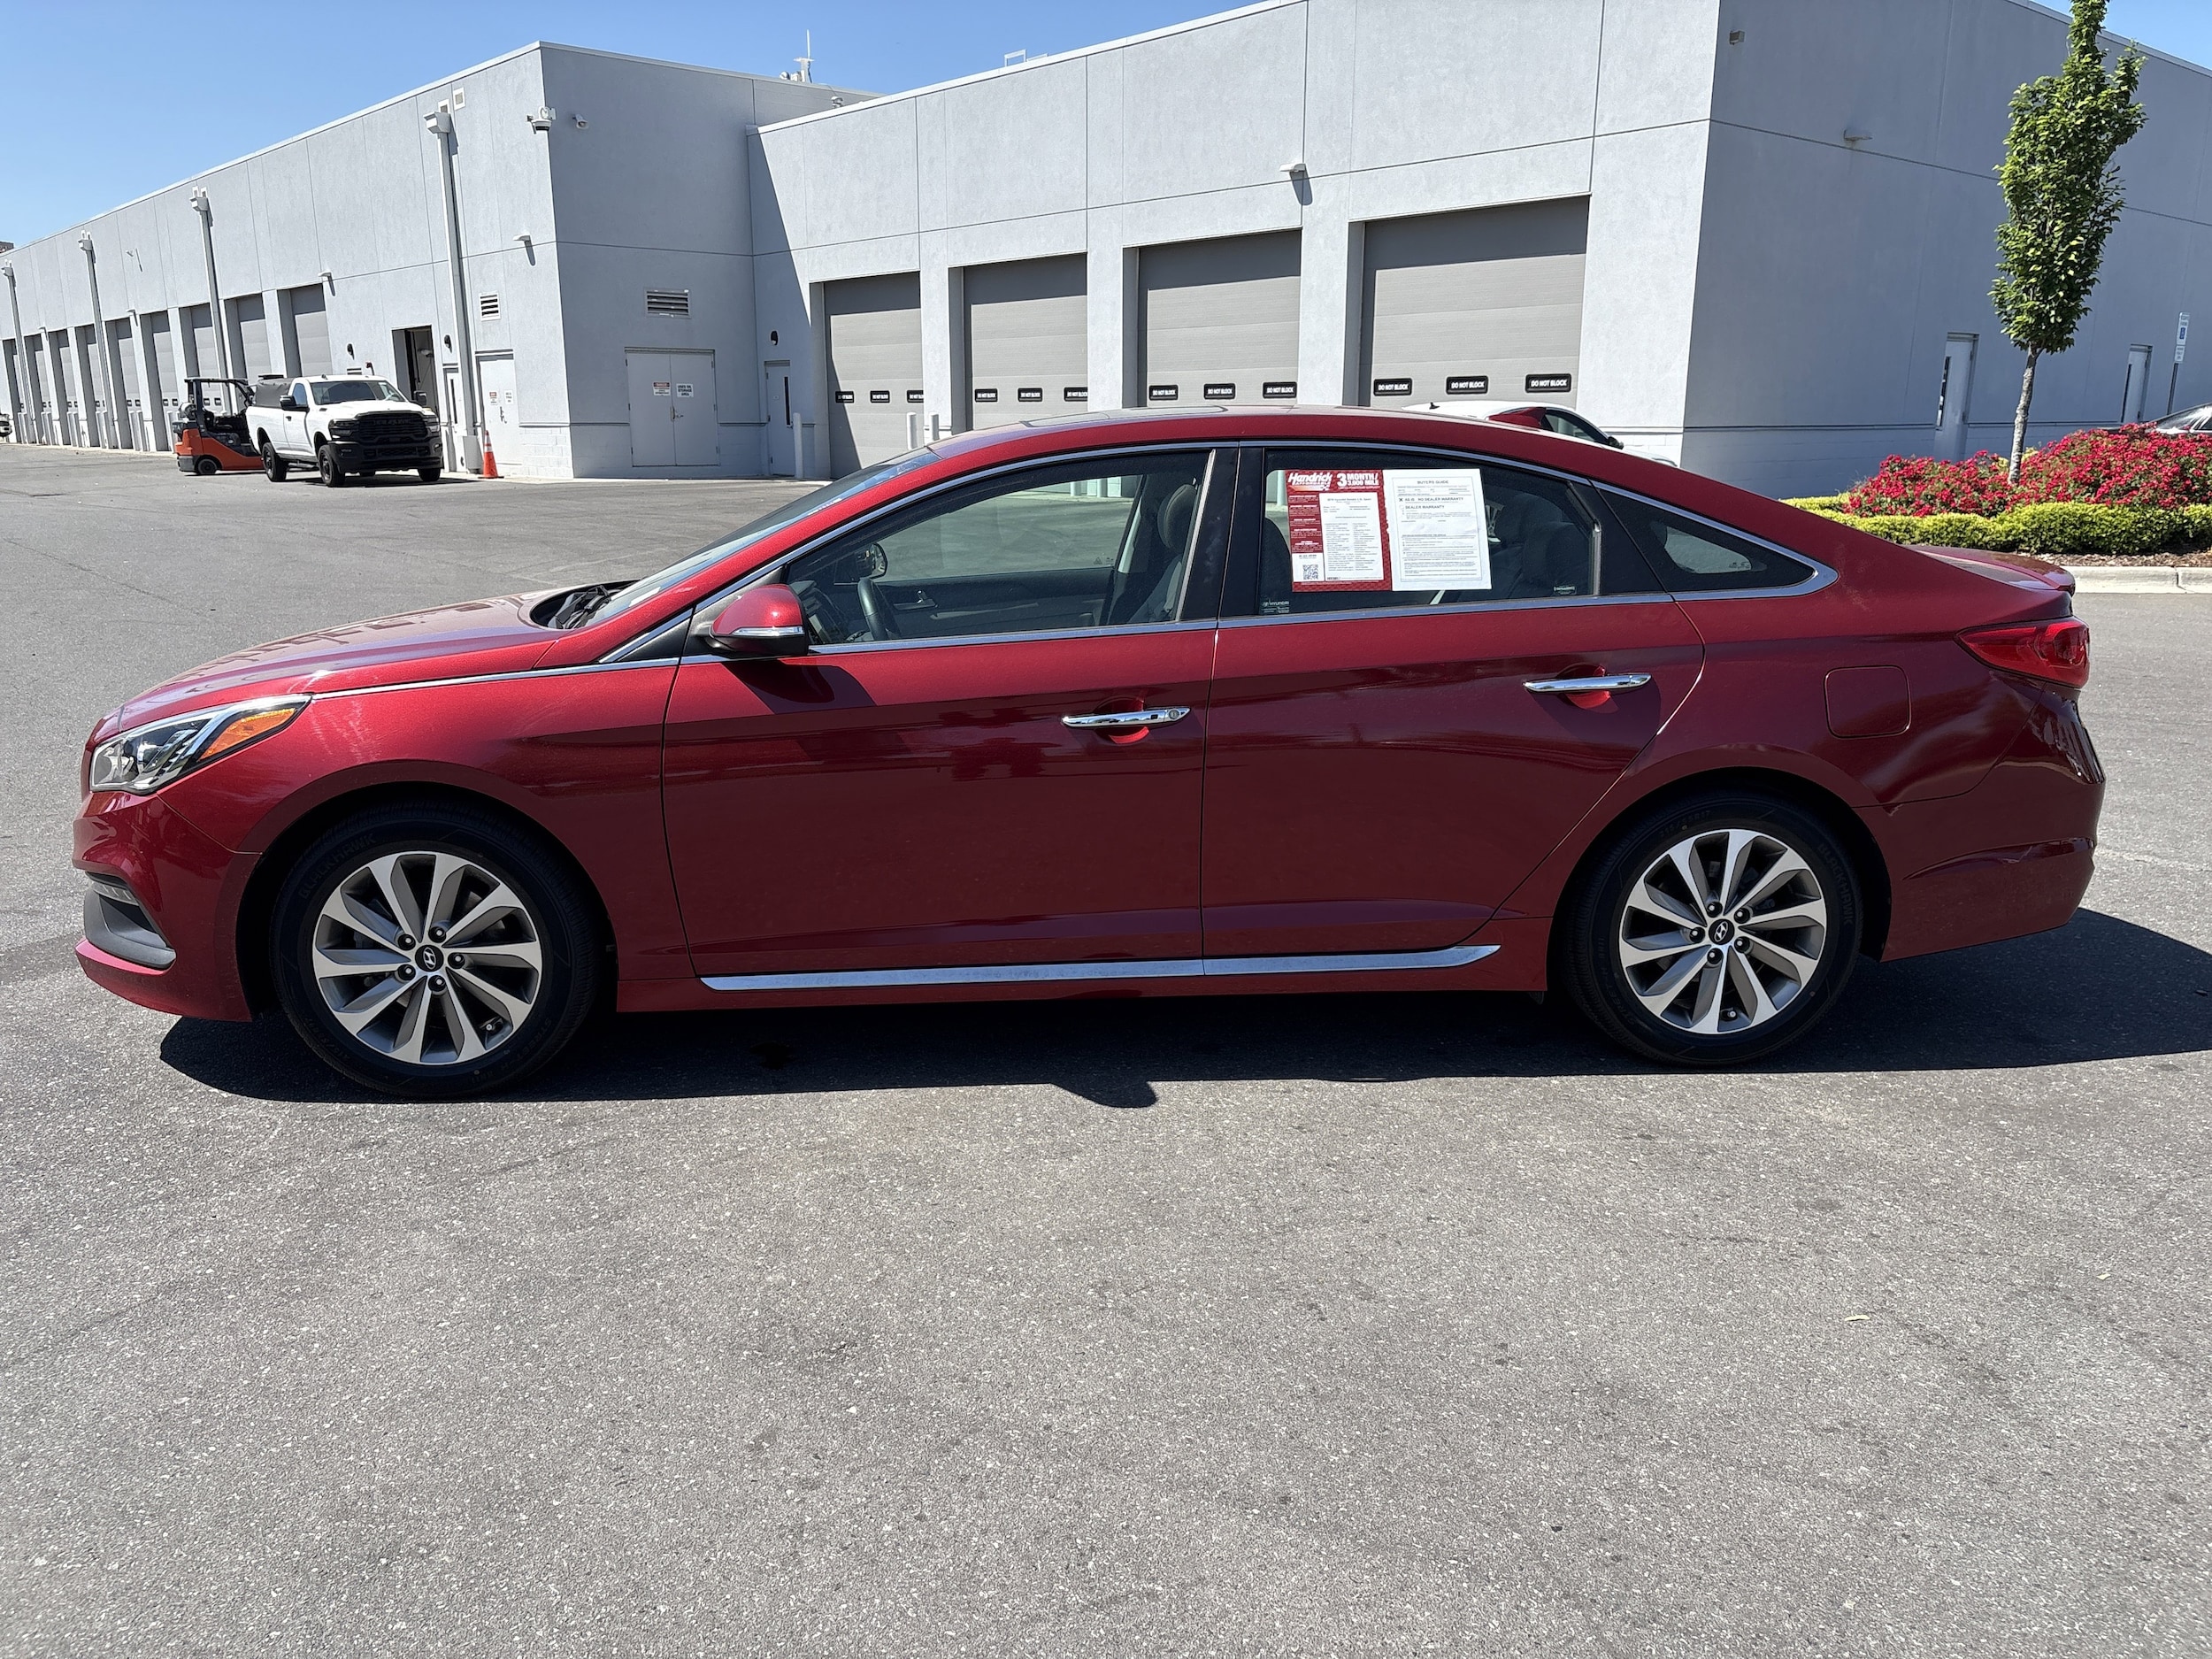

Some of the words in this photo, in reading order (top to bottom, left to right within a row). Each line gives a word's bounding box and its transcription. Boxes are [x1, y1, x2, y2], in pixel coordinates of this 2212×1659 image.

[1288, 472, 1333, 485] Hendrick
[1336, 473, 1347, 487] 3
[298, 833, 378, 900] BLACKHAWK
[1817, 842, 1854, 926] BLACKHAWK
